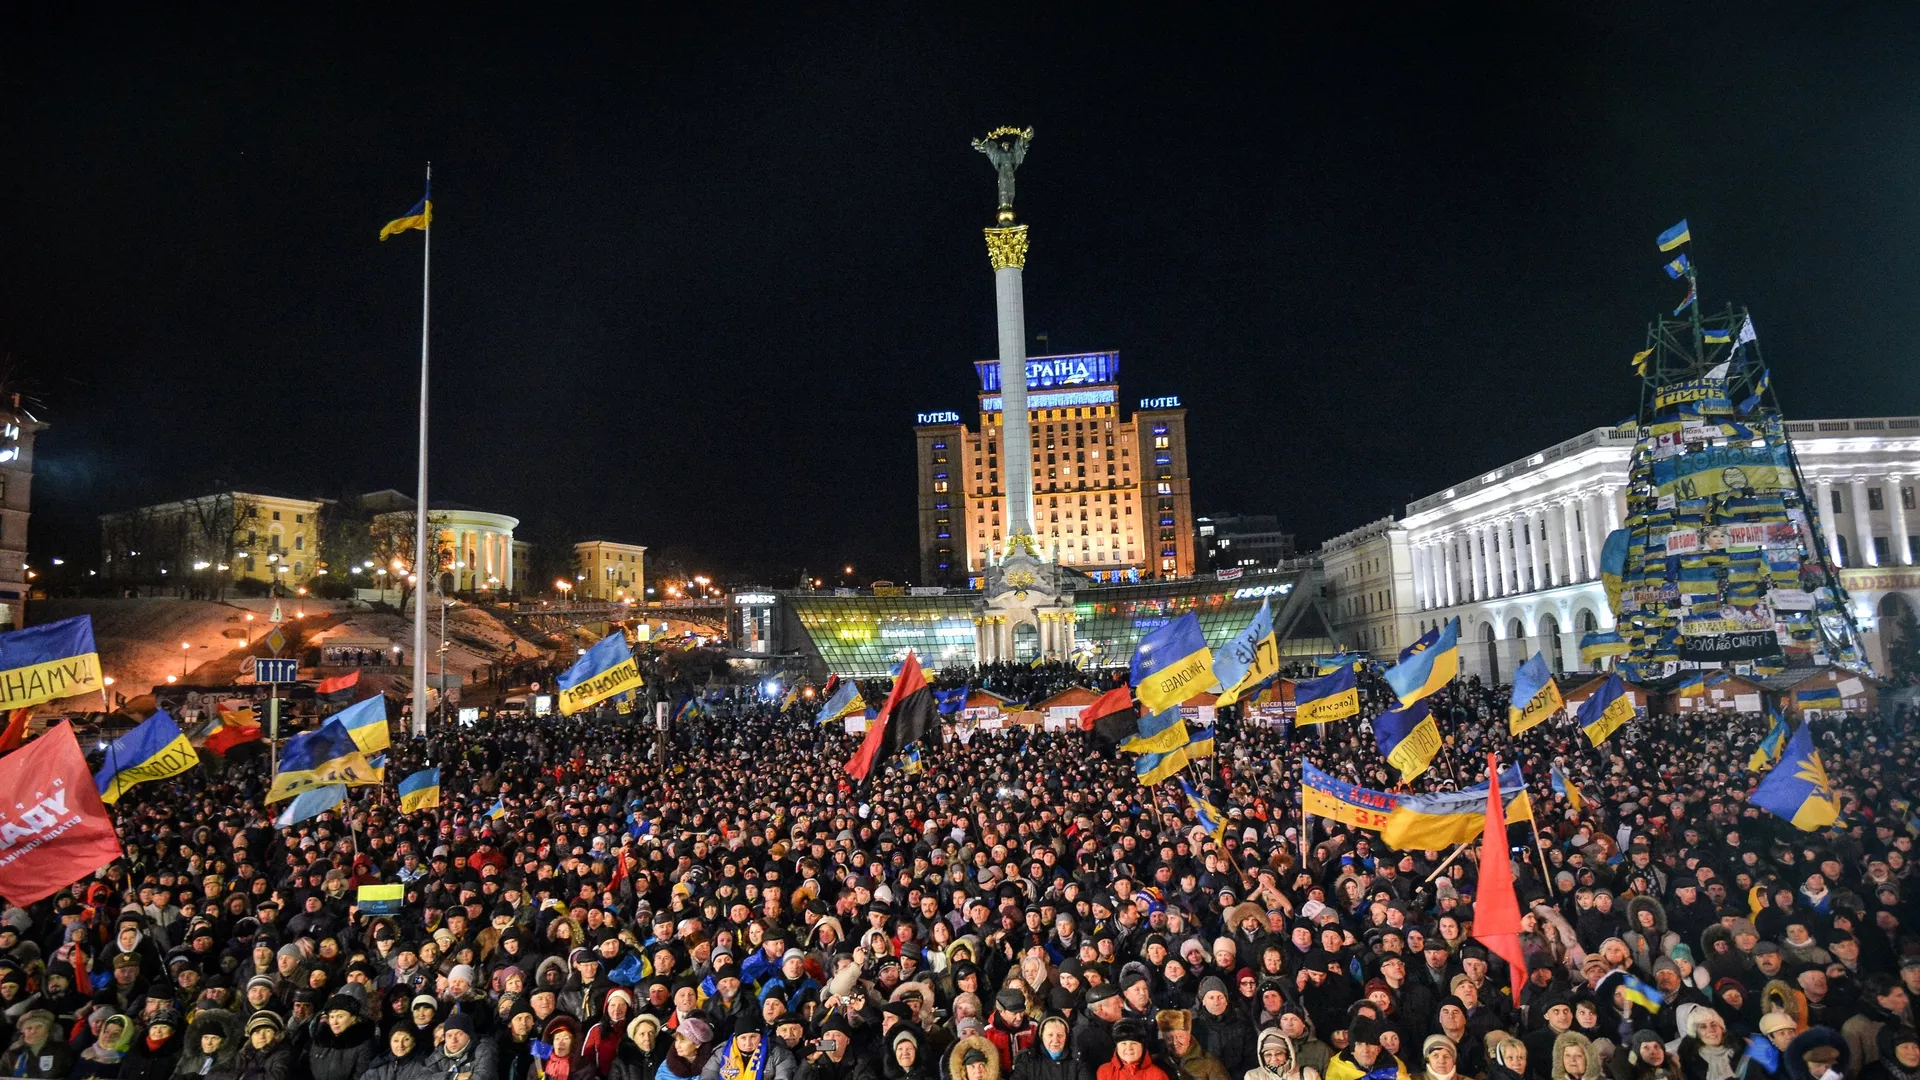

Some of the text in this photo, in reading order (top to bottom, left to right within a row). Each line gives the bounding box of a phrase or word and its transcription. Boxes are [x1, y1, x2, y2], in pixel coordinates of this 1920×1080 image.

[1140, 396, 1181, 408] HOTEL
[917, 411, 960, 424] ГОТЕЛЬ
[1716, 640, 1732, 651] АБО
[1732, 631, 1772, 648] СМЕРТЬ
